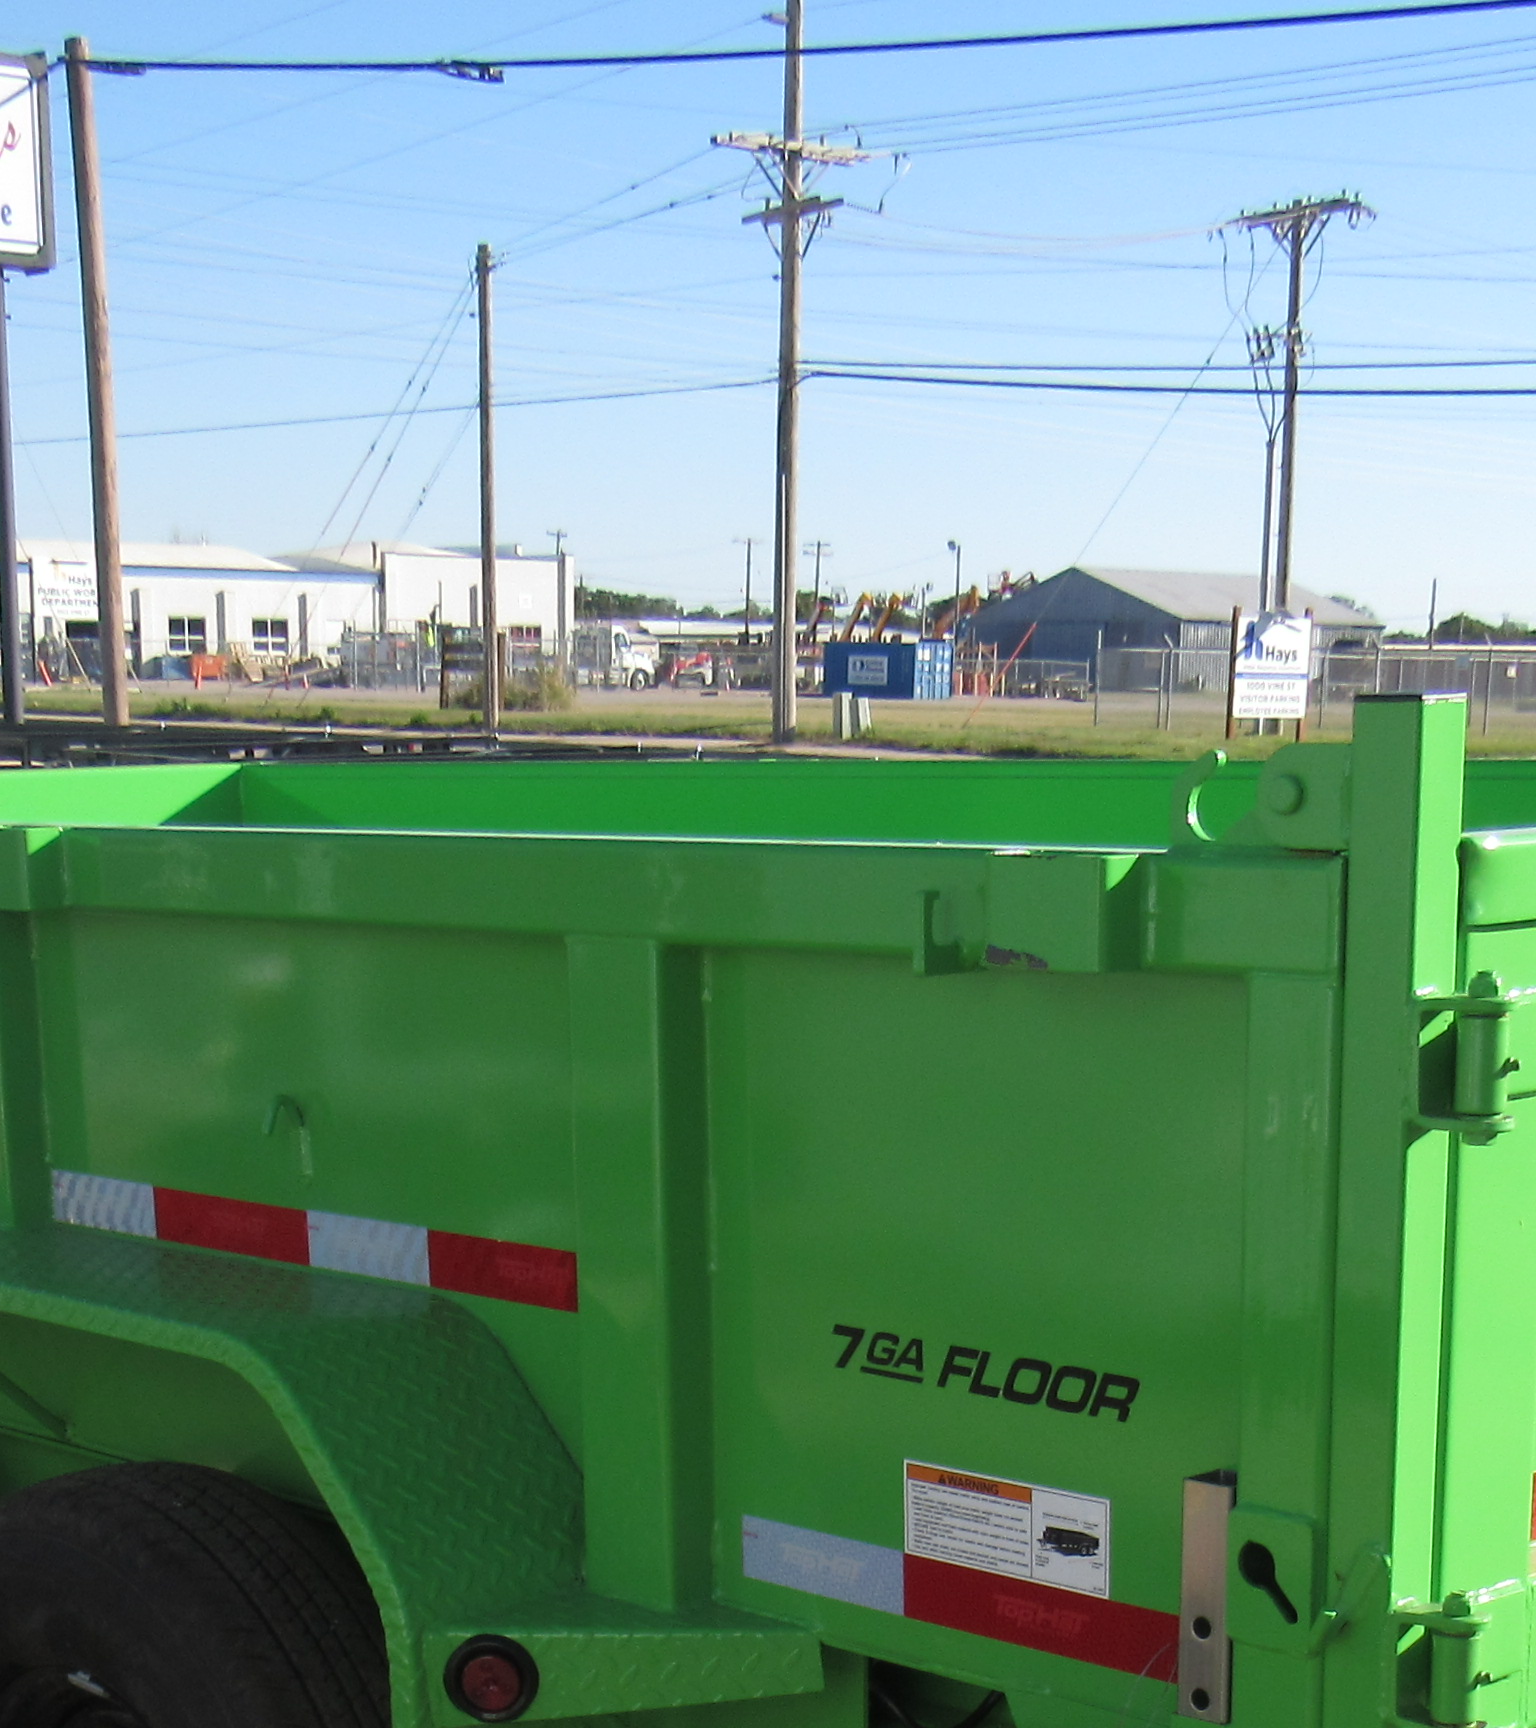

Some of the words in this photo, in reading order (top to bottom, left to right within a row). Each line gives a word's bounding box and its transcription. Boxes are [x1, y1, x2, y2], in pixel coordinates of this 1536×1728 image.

[68, 576, 92, 586] Hays
[38, 587, 70, 596] PUBLIC
[41, 597, 98, 606] DEPARTMEN
[1266, 645, 1298, 665] Hays
[1268, 682, 1284, 691] VINE
[1287, 682, 1296, 691] ST
[1240, 695, 1268, 703] VISITOR
[1270, 695, 1300, 703] PARKING
[937, 1345, 1141, 1423] FLOOR
[948, 1475, 999, 1496] WARNING
